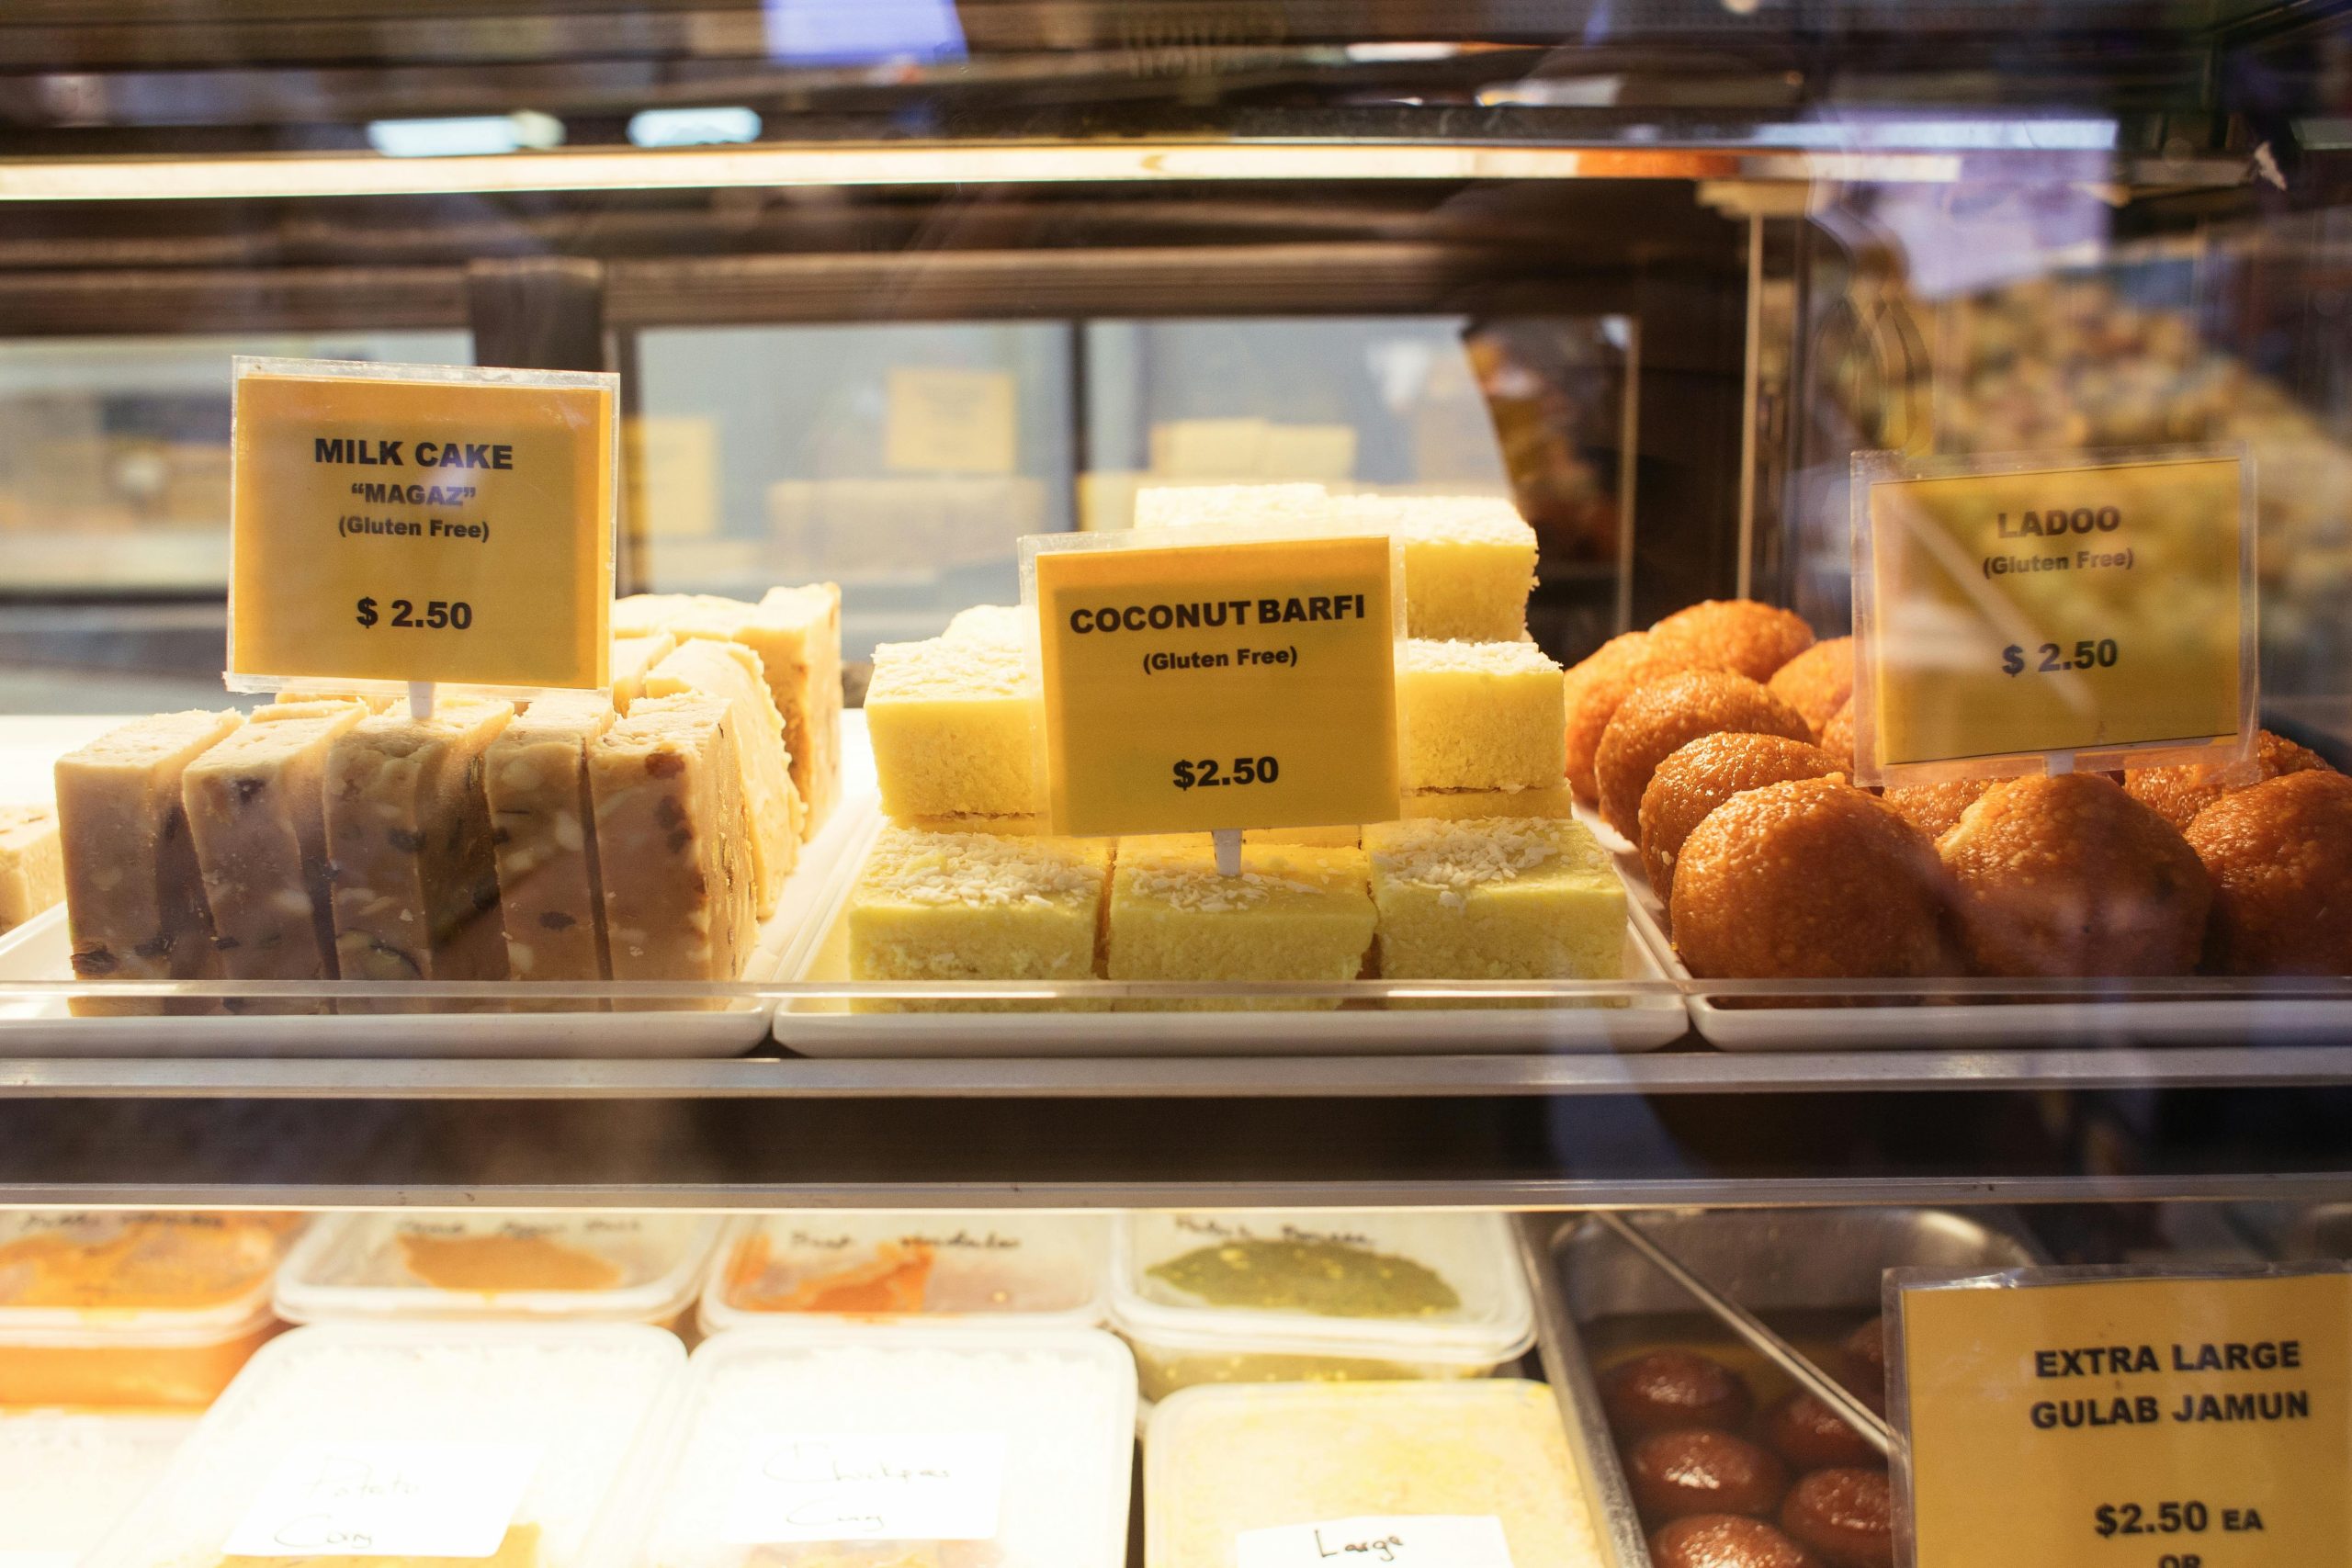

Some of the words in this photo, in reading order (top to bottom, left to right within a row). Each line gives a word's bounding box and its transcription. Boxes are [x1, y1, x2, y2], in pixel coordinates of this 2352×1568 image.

[315, 438, 404, 466] MILK
[415, 442, 513, 469] CAKE
[351, 482, 476, 506] “MAGAZ”
[338, 515, 422, 537] (Gluten
[430, 520, 490, 543] Free)
[1997, 506, 2120, 539] LADOO
[1983, 555, 2070, 580] (Gluten
[2075, 547, 2134, 570] Free)
[1069, 601, 1251, 634] COCONUT
[1258, 594, 1365, 625] BARFI
[1143, 652, 1229, 675] (Gluten
[1237, 646, 1298, 668] Free)
[1172, 756, 1280, 791] $2.50
[2034, 1345, 2159, 1377] EXTRA
[2171, 1340, 2301, 1371] LARGE
[2030, 1395, 2159, 1429] GULAB
[2172, 1390, 2309, 1422] JAMUN
[2094, 1500, 2208, 1538] $2.50
[2221, 1508, 2264, 1531] EA
[1314, 1529, 1403, 1562] Large
